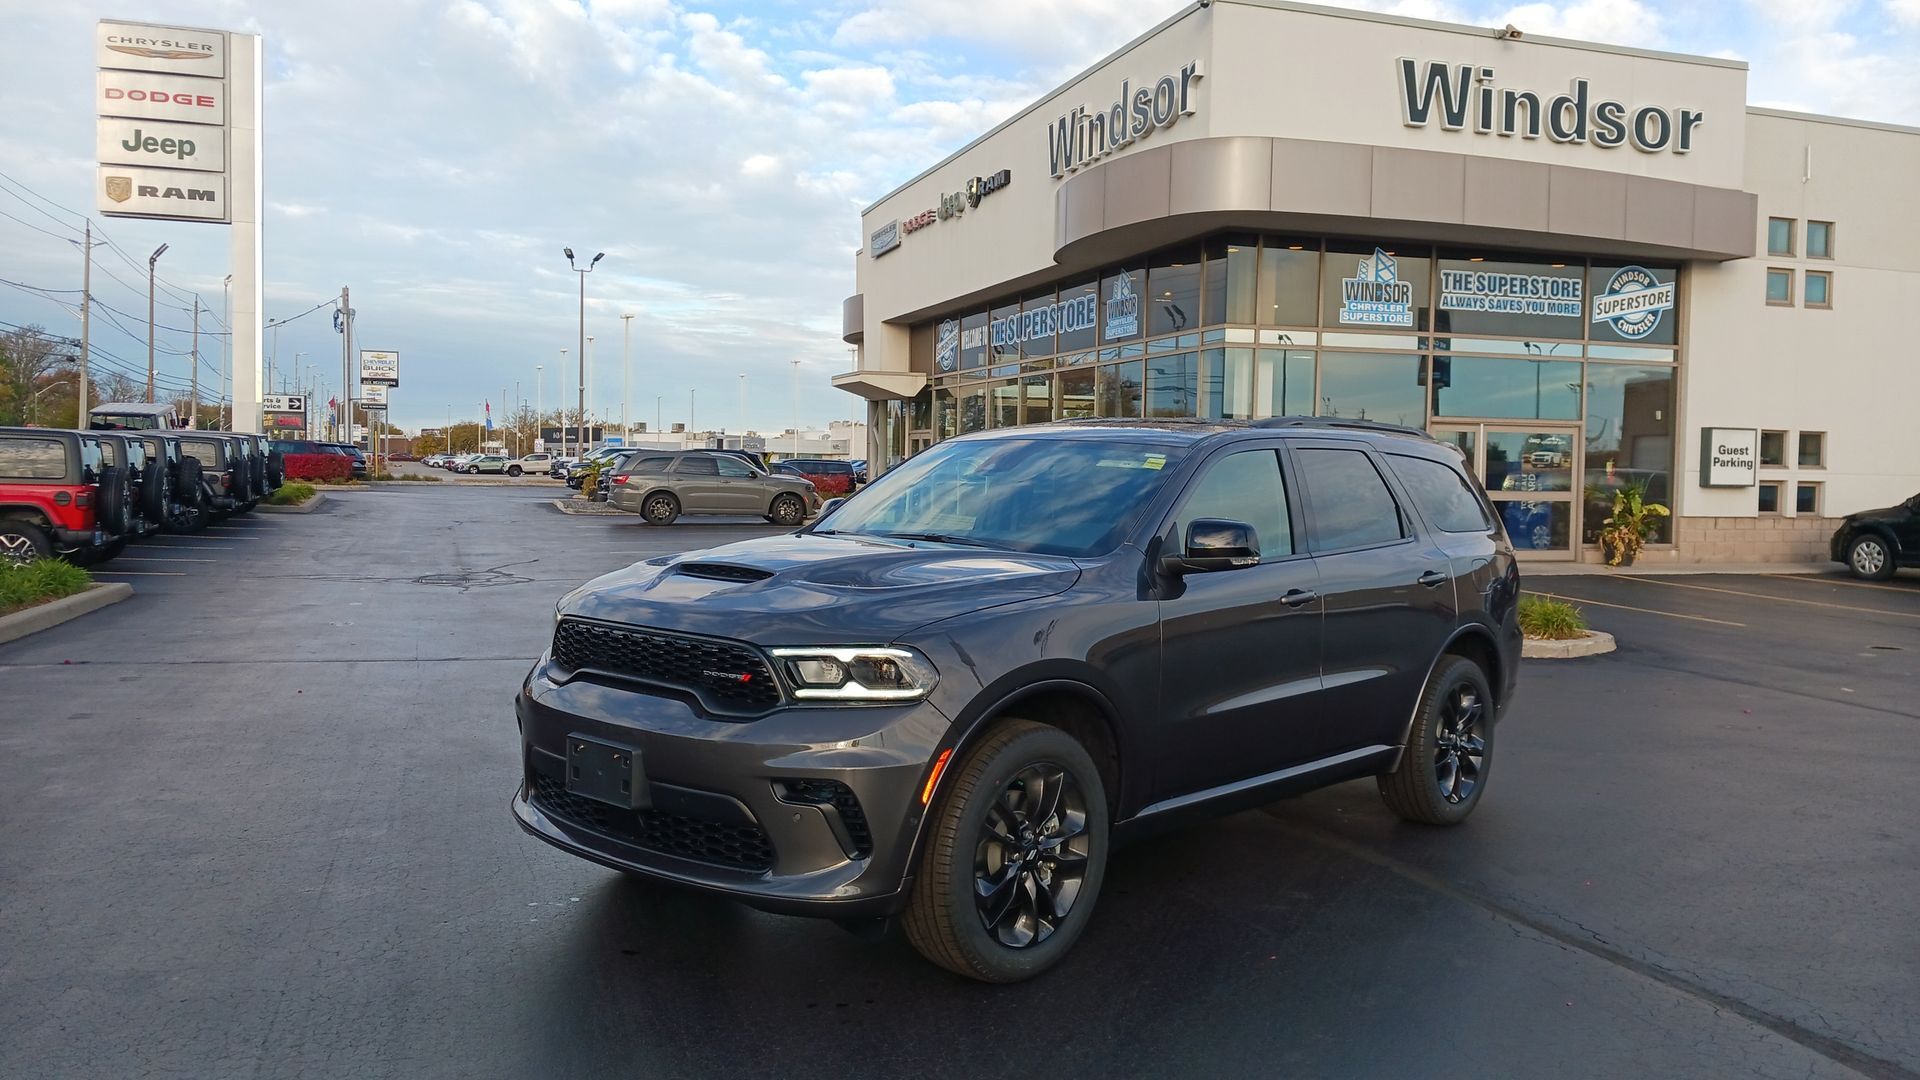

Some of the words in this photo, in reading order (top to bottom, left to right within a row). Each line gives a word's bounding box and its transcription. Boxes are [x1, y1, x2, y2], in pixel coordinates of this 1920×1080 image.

[106, 35, 213, 52] CHRYSLER
[105, 88, 215, 108] DODGE
[1397, 57, 1703, 153] Windsor
[1048, 59, 1204, 178] Windsor
[122, 129, 196, 160] Jeep
[137, 184, 216, 202] RAM
[976, 169, 1012, 197] RAM
[937, 191, 966, 221] Jeep
[871, 222, 897, 242] CHRYSLER
[1443, 272, 1474, 292] THE
[1476, 273, 1580, 298] SUPERSTORE
[1612, 271, 1650, 291] WINDSOR
[1345, 281, 1409, 304] WINDSOR
[1596, 290, 1671, 315] SUPERSTORE
[1350, 303, 1403, 312] CHRYSLER
[1442, 295, 1486, 310] ALWAYS
[1488, 299, 1523, 313] SAVES
[1524, 302, 1546, 313] YOU
[1547, 303, 1580, 315] MORE!
[992, 320, 1005, 346] THE
[1007, 296, 1096, 344] SUPERSTORE
[1343, 312, 1411, 323] SUPERSTORE
[1618, 313, 1655, 335] CHRYSLER
[1718, 445, 1749, 455] Guest
[1713, 457, 1753, 470] Parking
[703, 670, 743, 679] DODGE
